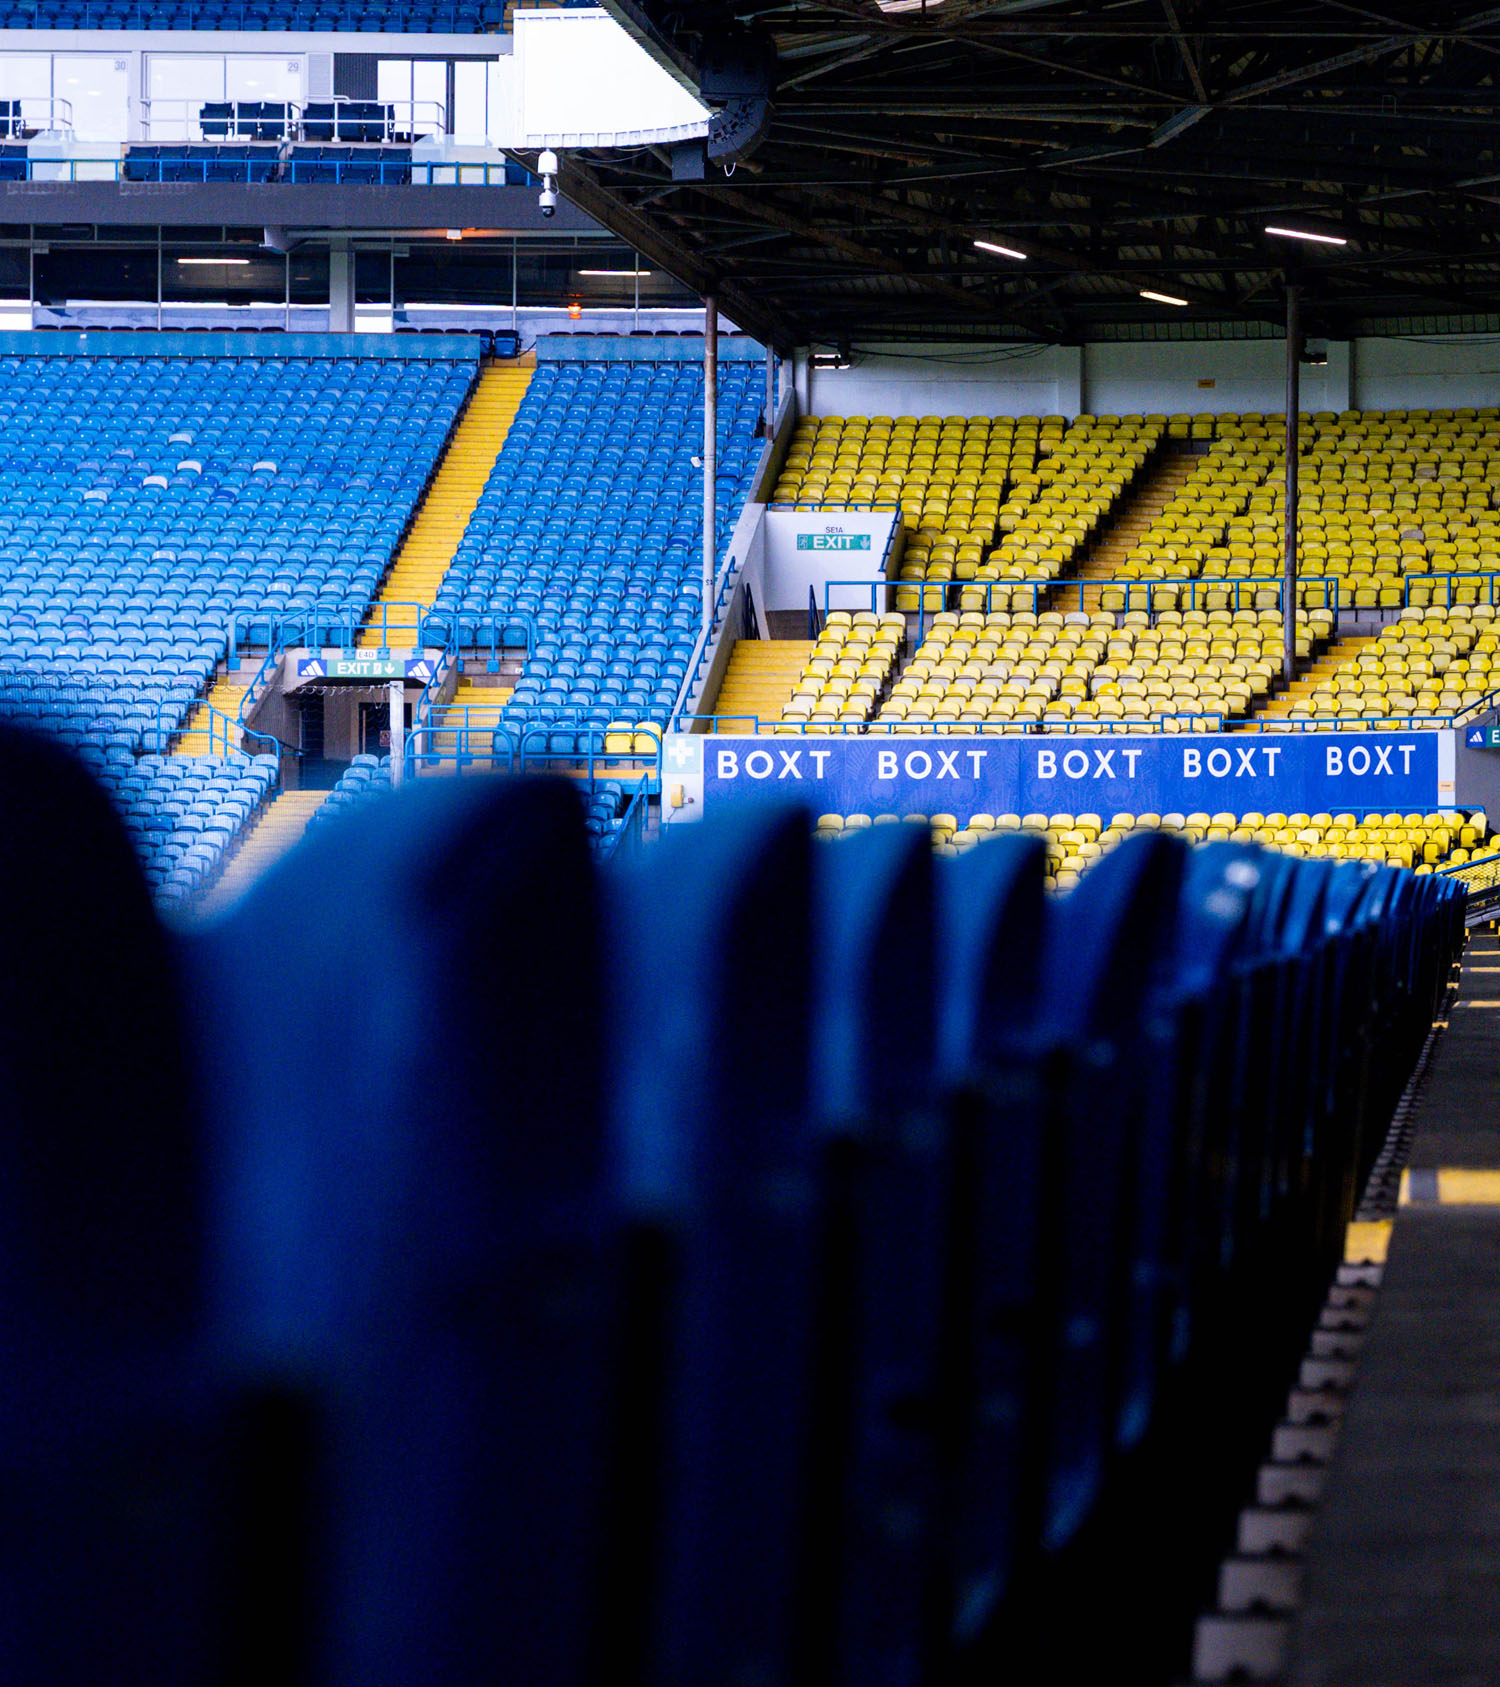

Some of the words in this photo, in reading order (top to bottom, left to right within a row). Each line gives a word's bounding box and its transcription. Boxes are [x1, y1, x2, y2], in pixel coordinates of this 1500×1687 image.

[114, 60, 126, 71] 30
[287, 62, 299, 72] 29
[813, 535, 855, 549] EXIT
[337, 662, 370, 675] EXIT
[717, 749, 831, 780] BOXT
[878, 750, 988, 780] BOXT
[1037, 749, 1142, 779] BOXT
[1183, 747, 1281, 778] BOXT
[1326, 744, 1416, 776] BOXT
